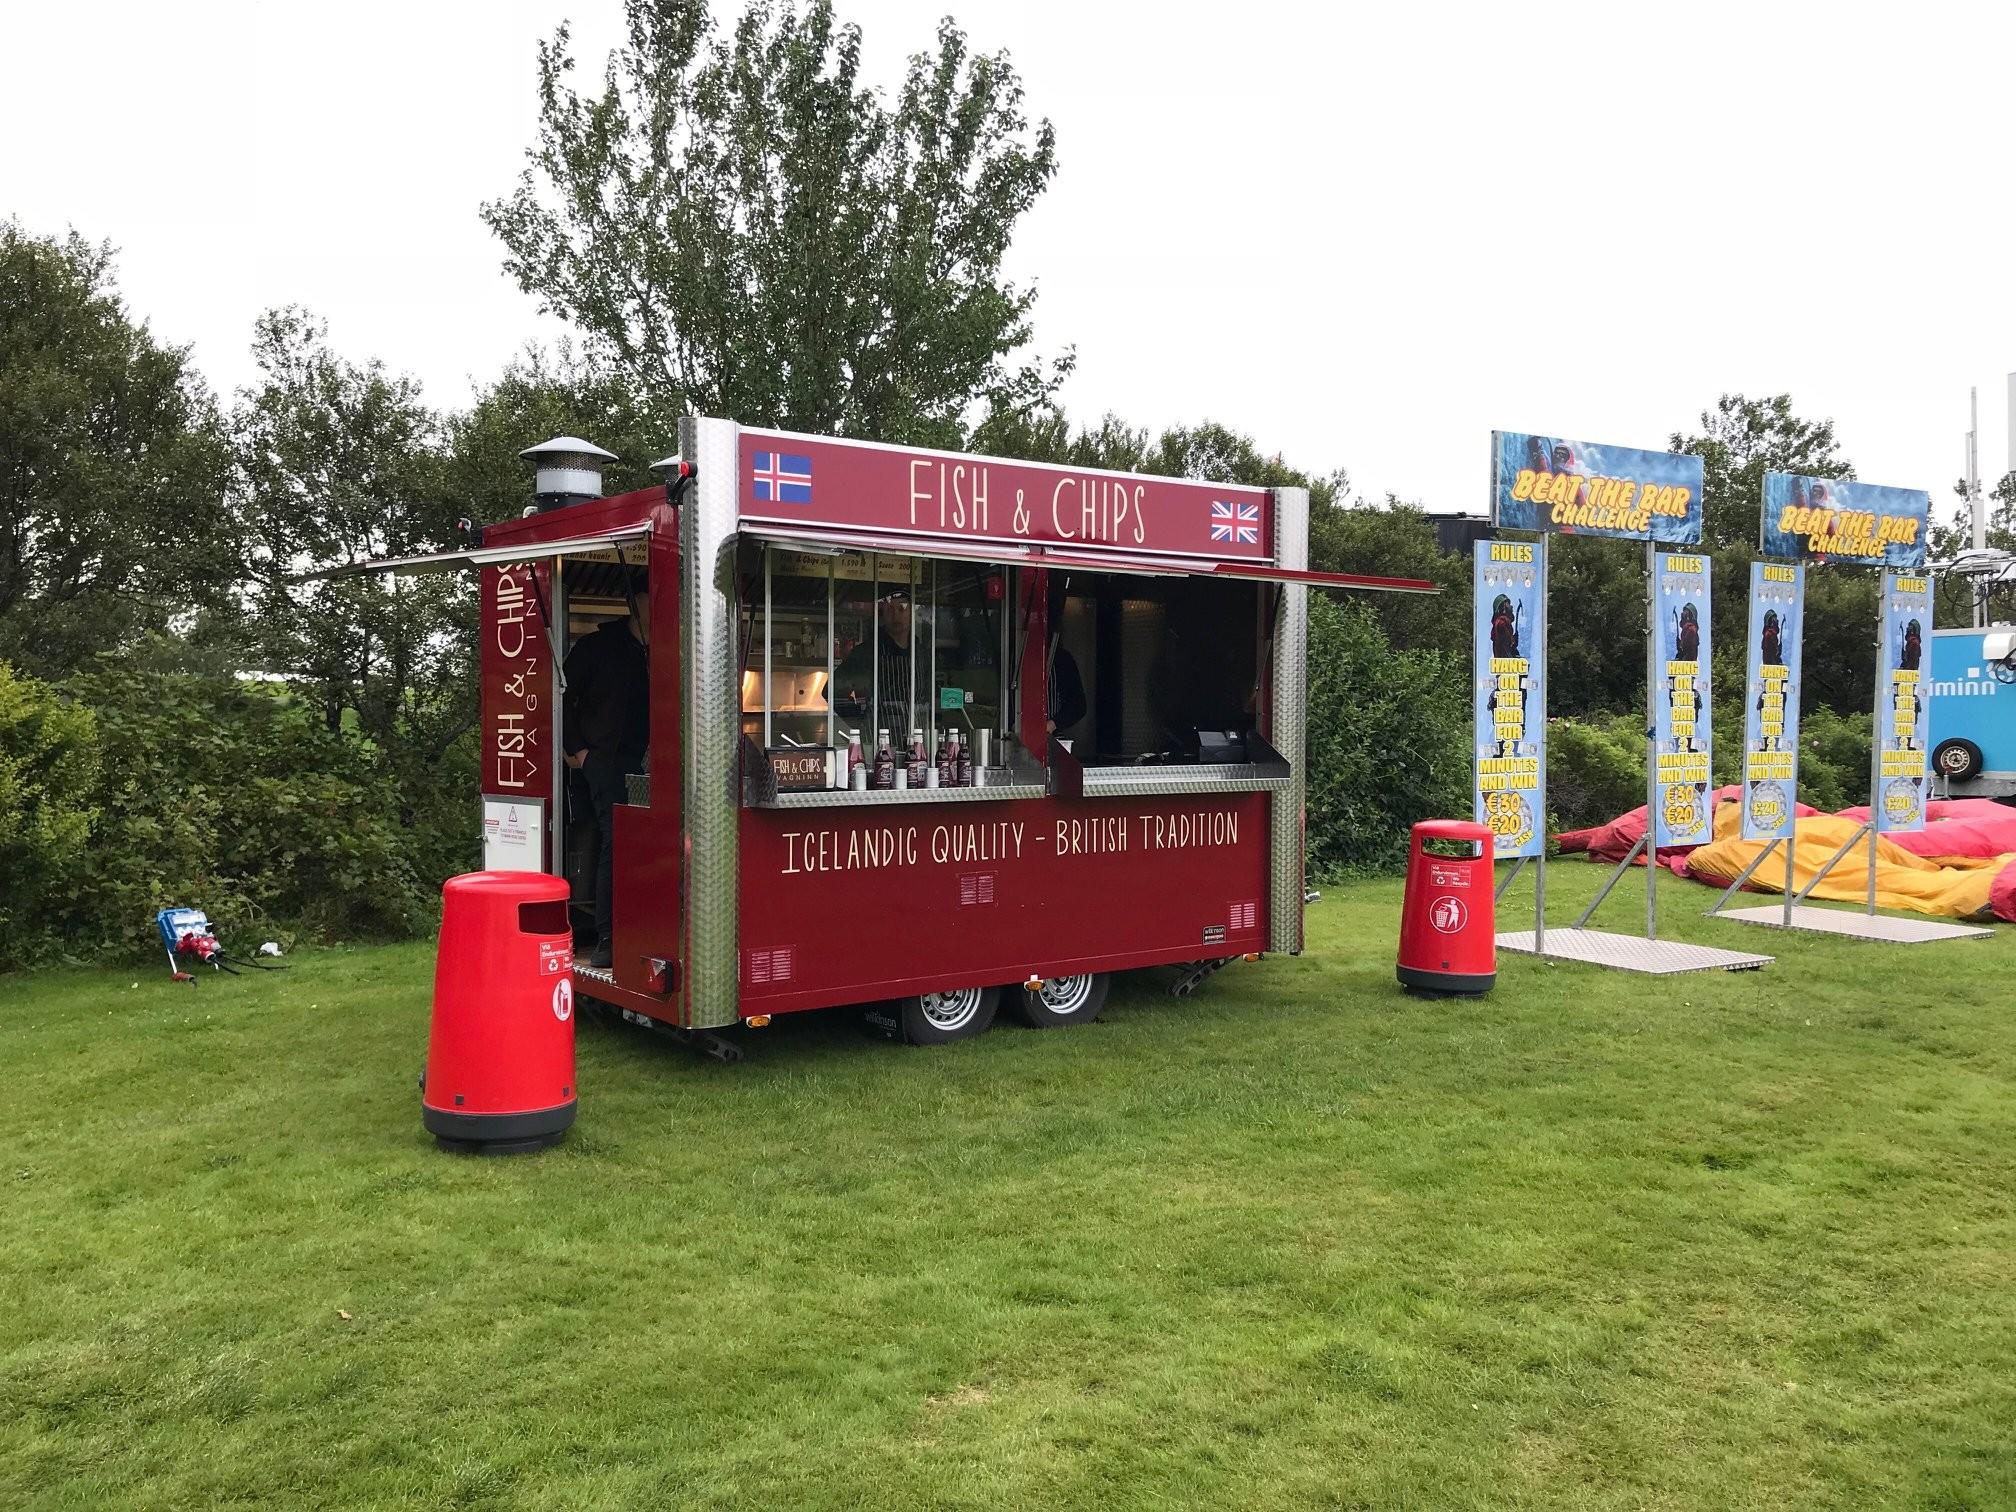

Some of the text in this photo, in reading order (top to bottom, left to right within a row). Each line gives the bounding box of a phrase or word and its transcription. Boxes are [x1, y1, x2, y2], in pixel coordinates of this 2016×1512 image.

[1512, 469, 1691, 518] BEAT THE BAR
[910, 460, 1145, 543] FISH & CHIPS
[1551, 502, 1652, 533] CHALLENGE
[1778, 505, 1919, 545] BEAT THE BAR
[1490, 543, 1533, 563] RULES
[1808, 534, 1887, 559] CHALLENGE
[1667, 556, 1702, 574] RULES
[1763, 565, 1795, 582] RULES
[1896, 577, 1927, 594] RULES
[1490, 658, 1528, 674] HANG
[1667, 661, 1699, 675] HANG
[1760, 665, 1788, 679] HANG
[497, 563, 524, 787] FISH & CHIPS
[1499, 675, 1519, 690] ON
[1893, 670, 1919, 682] HANG
[1675, 678, 1692, 691] ON
[1766, 680, 1781, 693] ON
[1898, 684, 1913, 697] ON
[1929, 677, 1996, 696] íminn
[1496, 691, 1522, 707] THE
[1673, 692, 1694, 706] THE
[1763, 694, 1783, 707] THE
[1896, 697, 1915, 710] THE
[1495, 708, 1523, 724] BAR
[1672, 707, 1695, 721] BAR
[1762, 708, 1783, 722] BAR
[1895, 711, 1915, 723] BAR
[1495, 725, 1522, 740] FOR
[1672, 723, 1693, 737] FOR
[1762, 723, 1782, 737] FOR
[1895, 724, 1914, 736] FOR
[1503, 741, 1514, 757] 2
[1679, 738, 1687, 752] 2
[1658, 753, 1708, 768] MINUTES
[1748, 753, 1793, 766] MINUTES
[1881, 751, 1925, 763] MINUTES
[774, 758, 820, 773] FISH & CHIPS
[1479, 758, 1538, 774] MINUTES
[1881, 765, 1924, 777] AND WIN
[1658, 768, 1707, 783] AND WIN
[1748, 767, 1792, 780] AND WIN
[1479, 774, 1538, 791] AND WIN
[1665, 805, 1694, 825] €20
[1487, 814, 1521, 836] €20
[782, 827, 917, 874] ICELANDIC
[932, 822, 1024, 864] QUALITY
[1056, 817, 1127, 856] BRITISH
[1139, 811, 1238, 850] TRADITION
[1515, 829, 1535, 847] CASH
